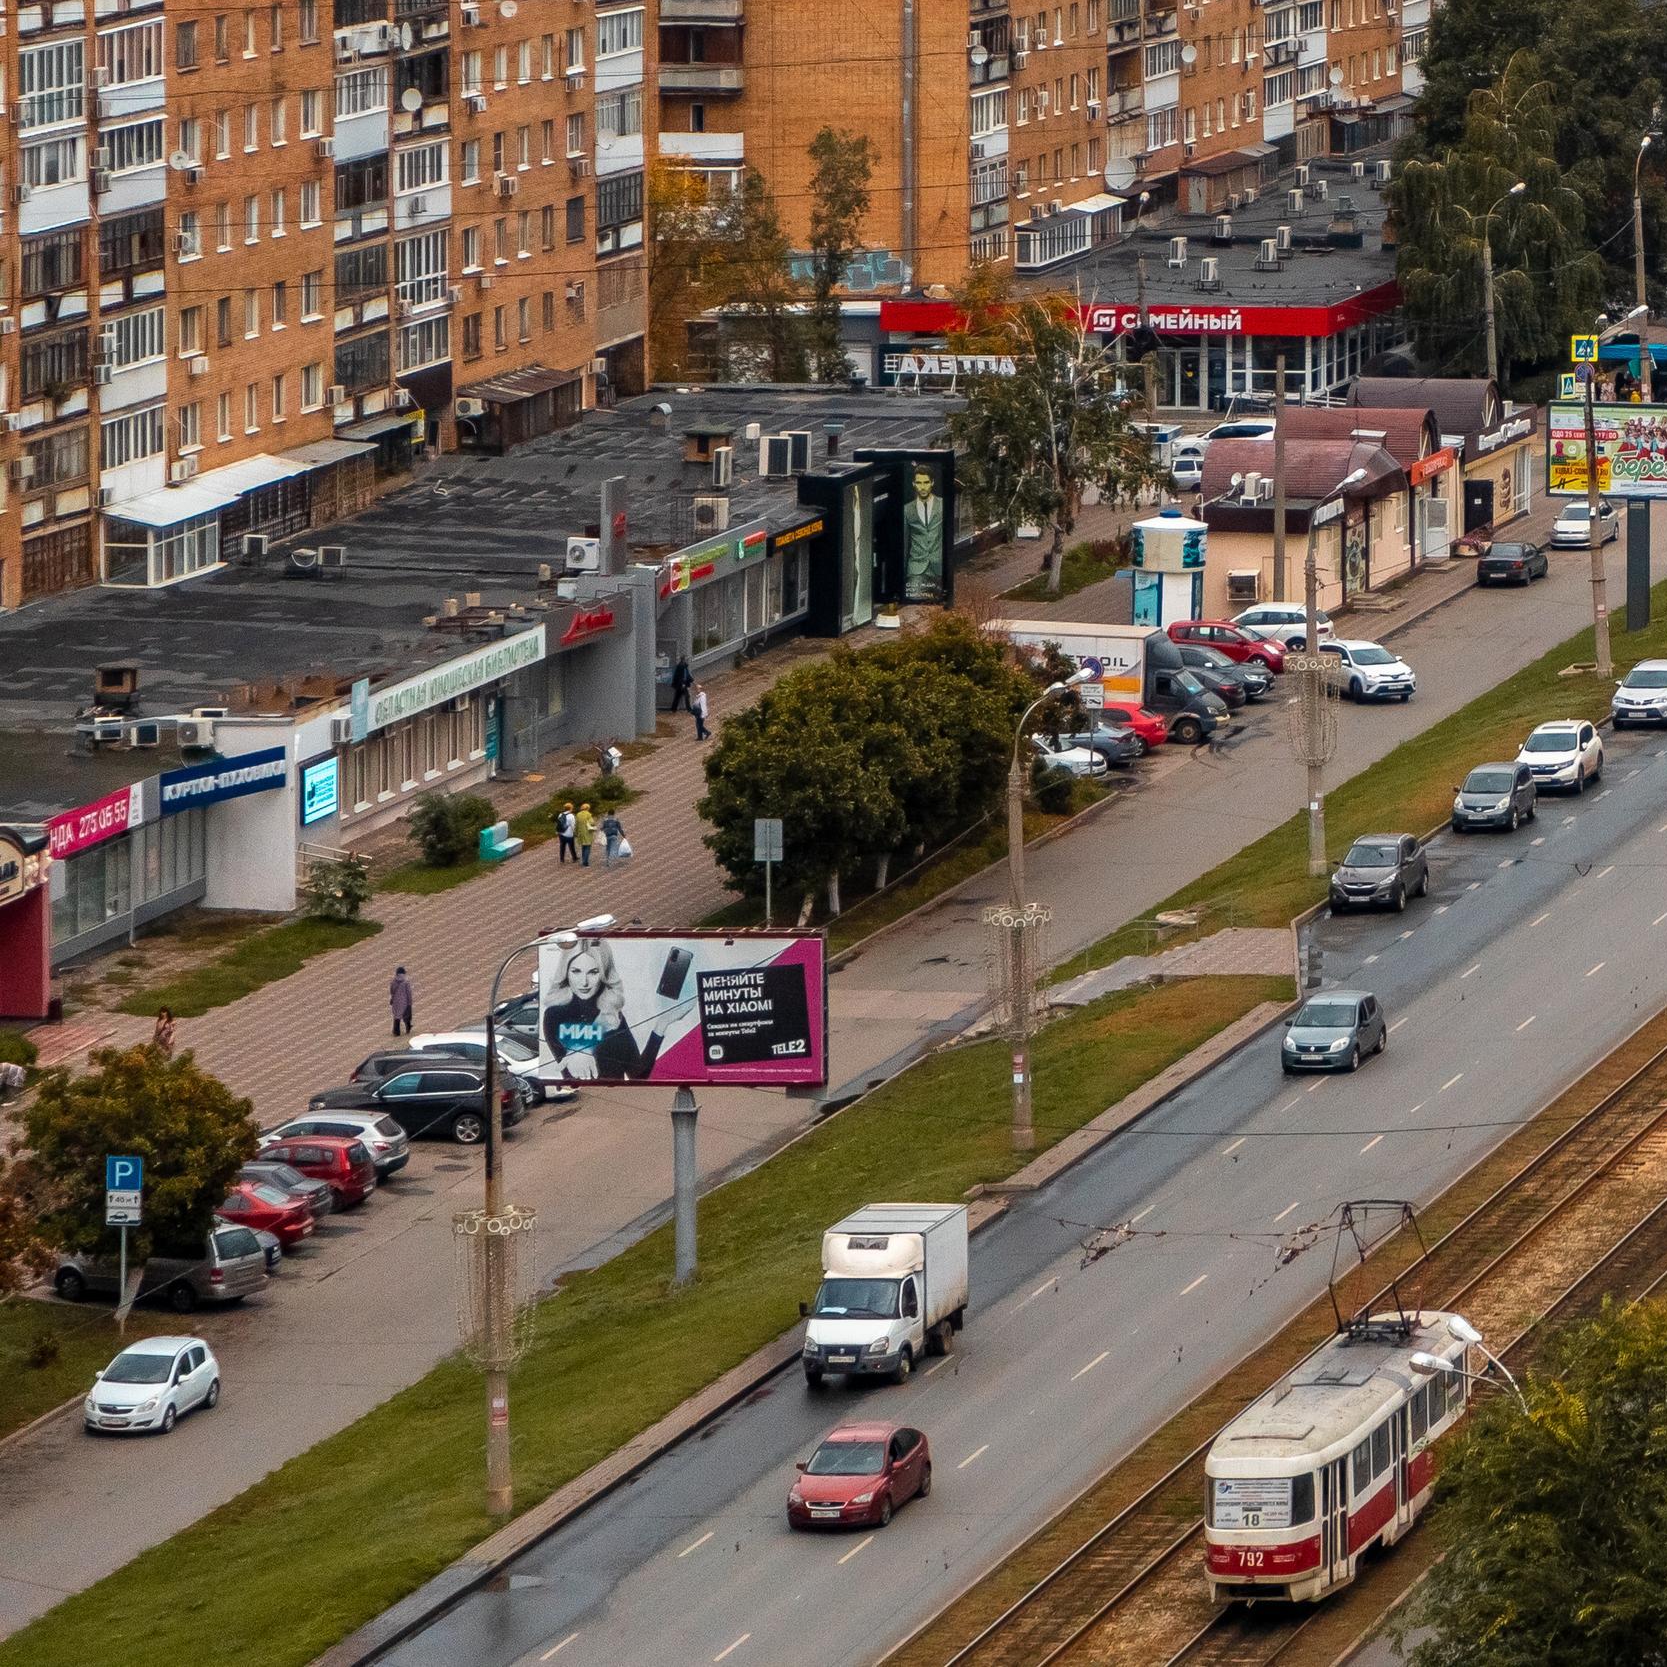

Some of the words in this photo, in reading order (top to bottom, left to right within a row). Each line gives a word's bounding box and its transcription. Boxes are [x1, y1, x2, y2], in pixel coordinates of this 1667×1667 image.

[375, 682, 427, 725] ОБЛАСТНАЯ
[430, 658, 483, 701] ЮНОШЕСКАЯ
[485, 635, 539, 678] БИБЛИОТЕКА
[79, 812, 98, 838] 275
[702, 971, 765, 988] МЕНЯЙТЕ
[704, 987, 762, 1002] МИНУТЫ
[705, 1004, 723, 1015] НА
[727, 999, 773, 1014] XIAOMI
[739, 1019, 774, 1028] смартфоны
[559, 1023, 602, 1041] МИН
[772, 1039, 806, 1055] TELE2
[115, 1161, 133, 1187] P
[1242, 1514, 1260, 1526] 18
[1238, 1552, 1264, 1566] 792
